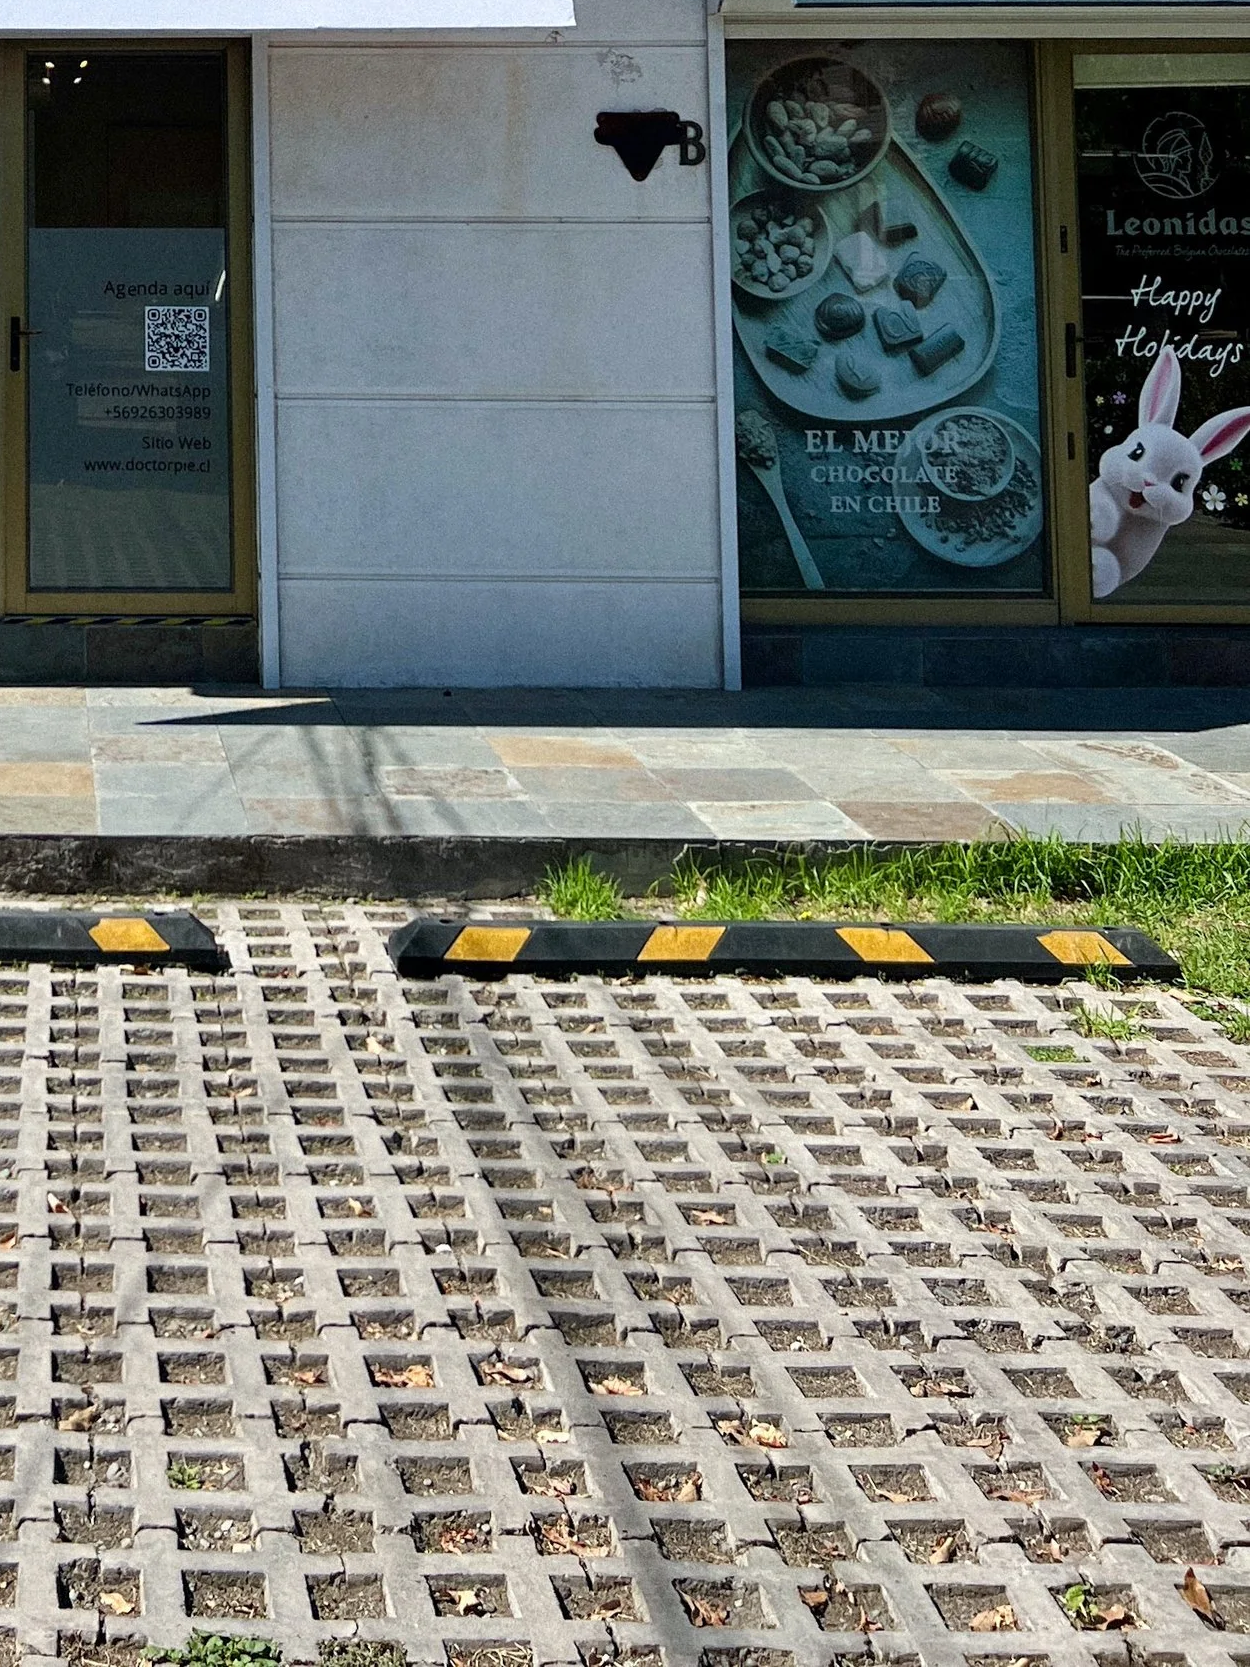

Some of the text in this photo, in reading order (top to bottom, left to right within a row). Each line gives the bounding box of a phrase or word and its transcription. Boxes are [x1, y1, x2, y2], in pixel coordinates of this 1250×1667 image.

[679, 121, 705, 166] B
[103, 280, 210, 300] Agenda aquí
[1131, 274, 1222, 323] Happy
[66, 383, 211, 402] Teléfono/WhatsApp
[141, 435, 212, 450] Sitio Web
[804, 429, 963, 457] EL MEJOR
[84, 457, 211, 474] www.doctorpie.cl
[810, 464, 959, 484] CHOCOLATE
[829, 495, 942, 514] EN CHILE
